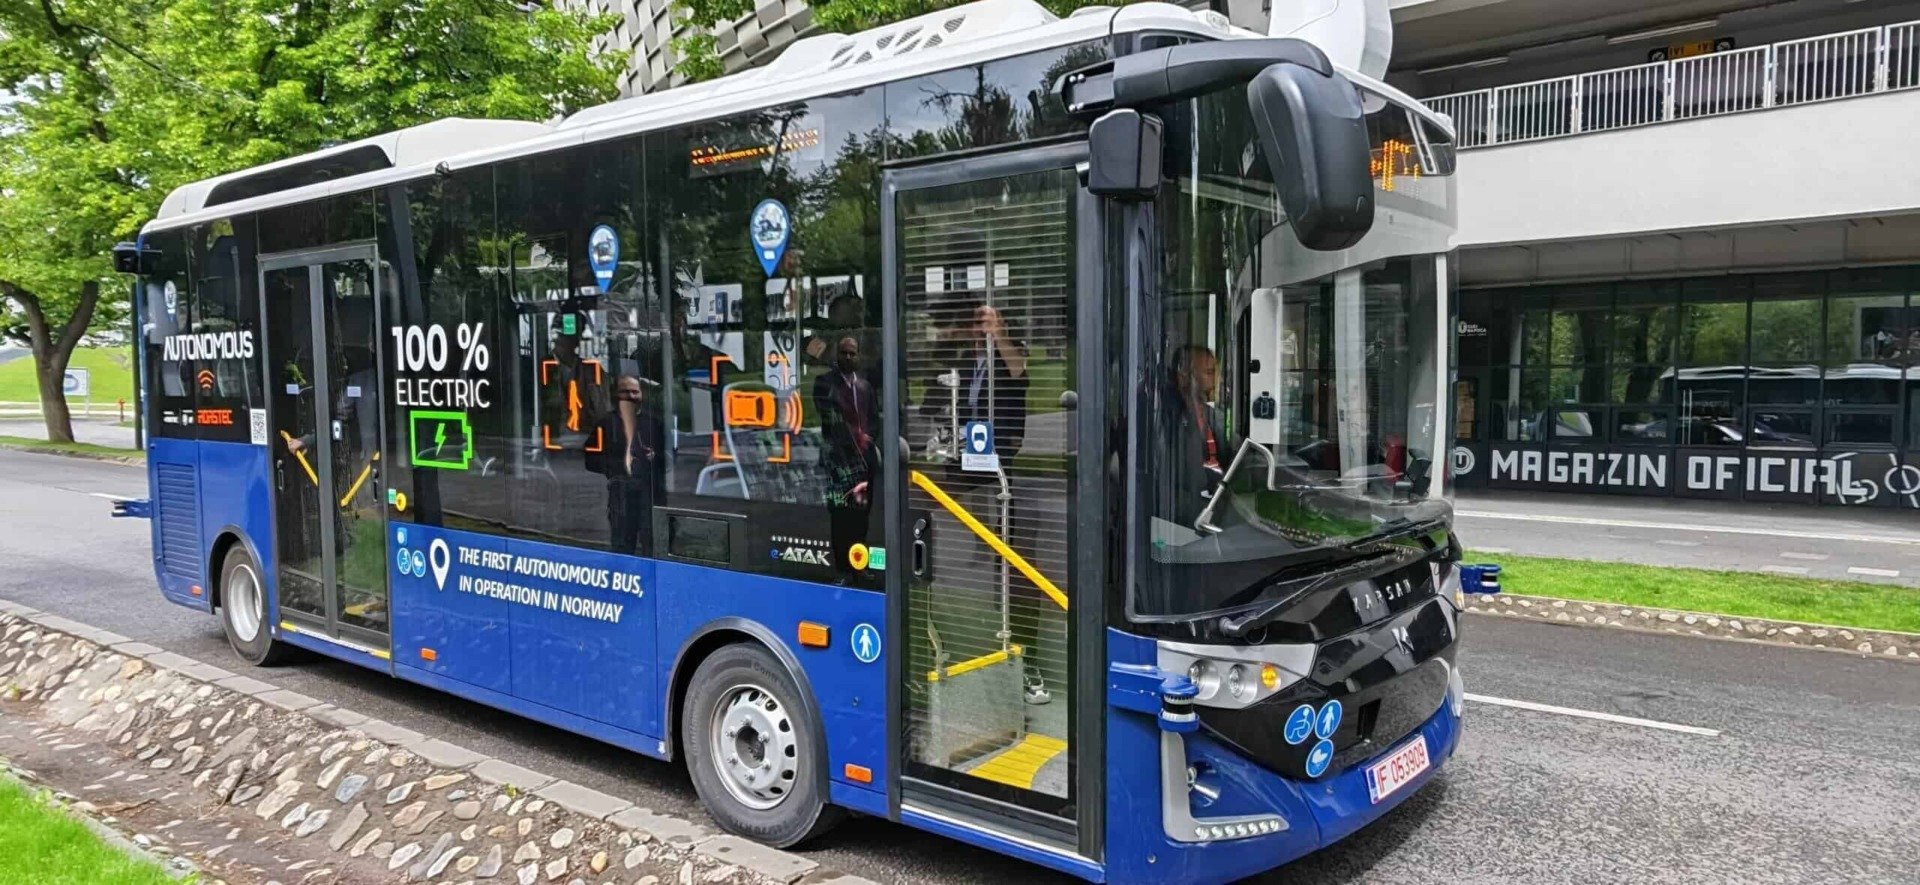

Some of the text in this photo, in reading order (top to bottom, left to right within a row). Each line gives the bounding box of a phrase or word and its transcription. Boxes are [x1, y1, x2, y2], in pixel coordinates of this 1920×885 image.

[163, 330, 254, 361] AUTONOMOUS
[391, 322, 490, 372] 100 %
[396, 378, 491, 408] ELECTRIC
[1491, 449, 1868, 496] MAGAZIN OFICIAL
[458, 546, 644, 598] THE FIRST AUTONOMOUS BUS,
[769, 545, 831, 567] e-ATAK
[459, 575, 624, 624] IN OPERATION IN NORWAY
